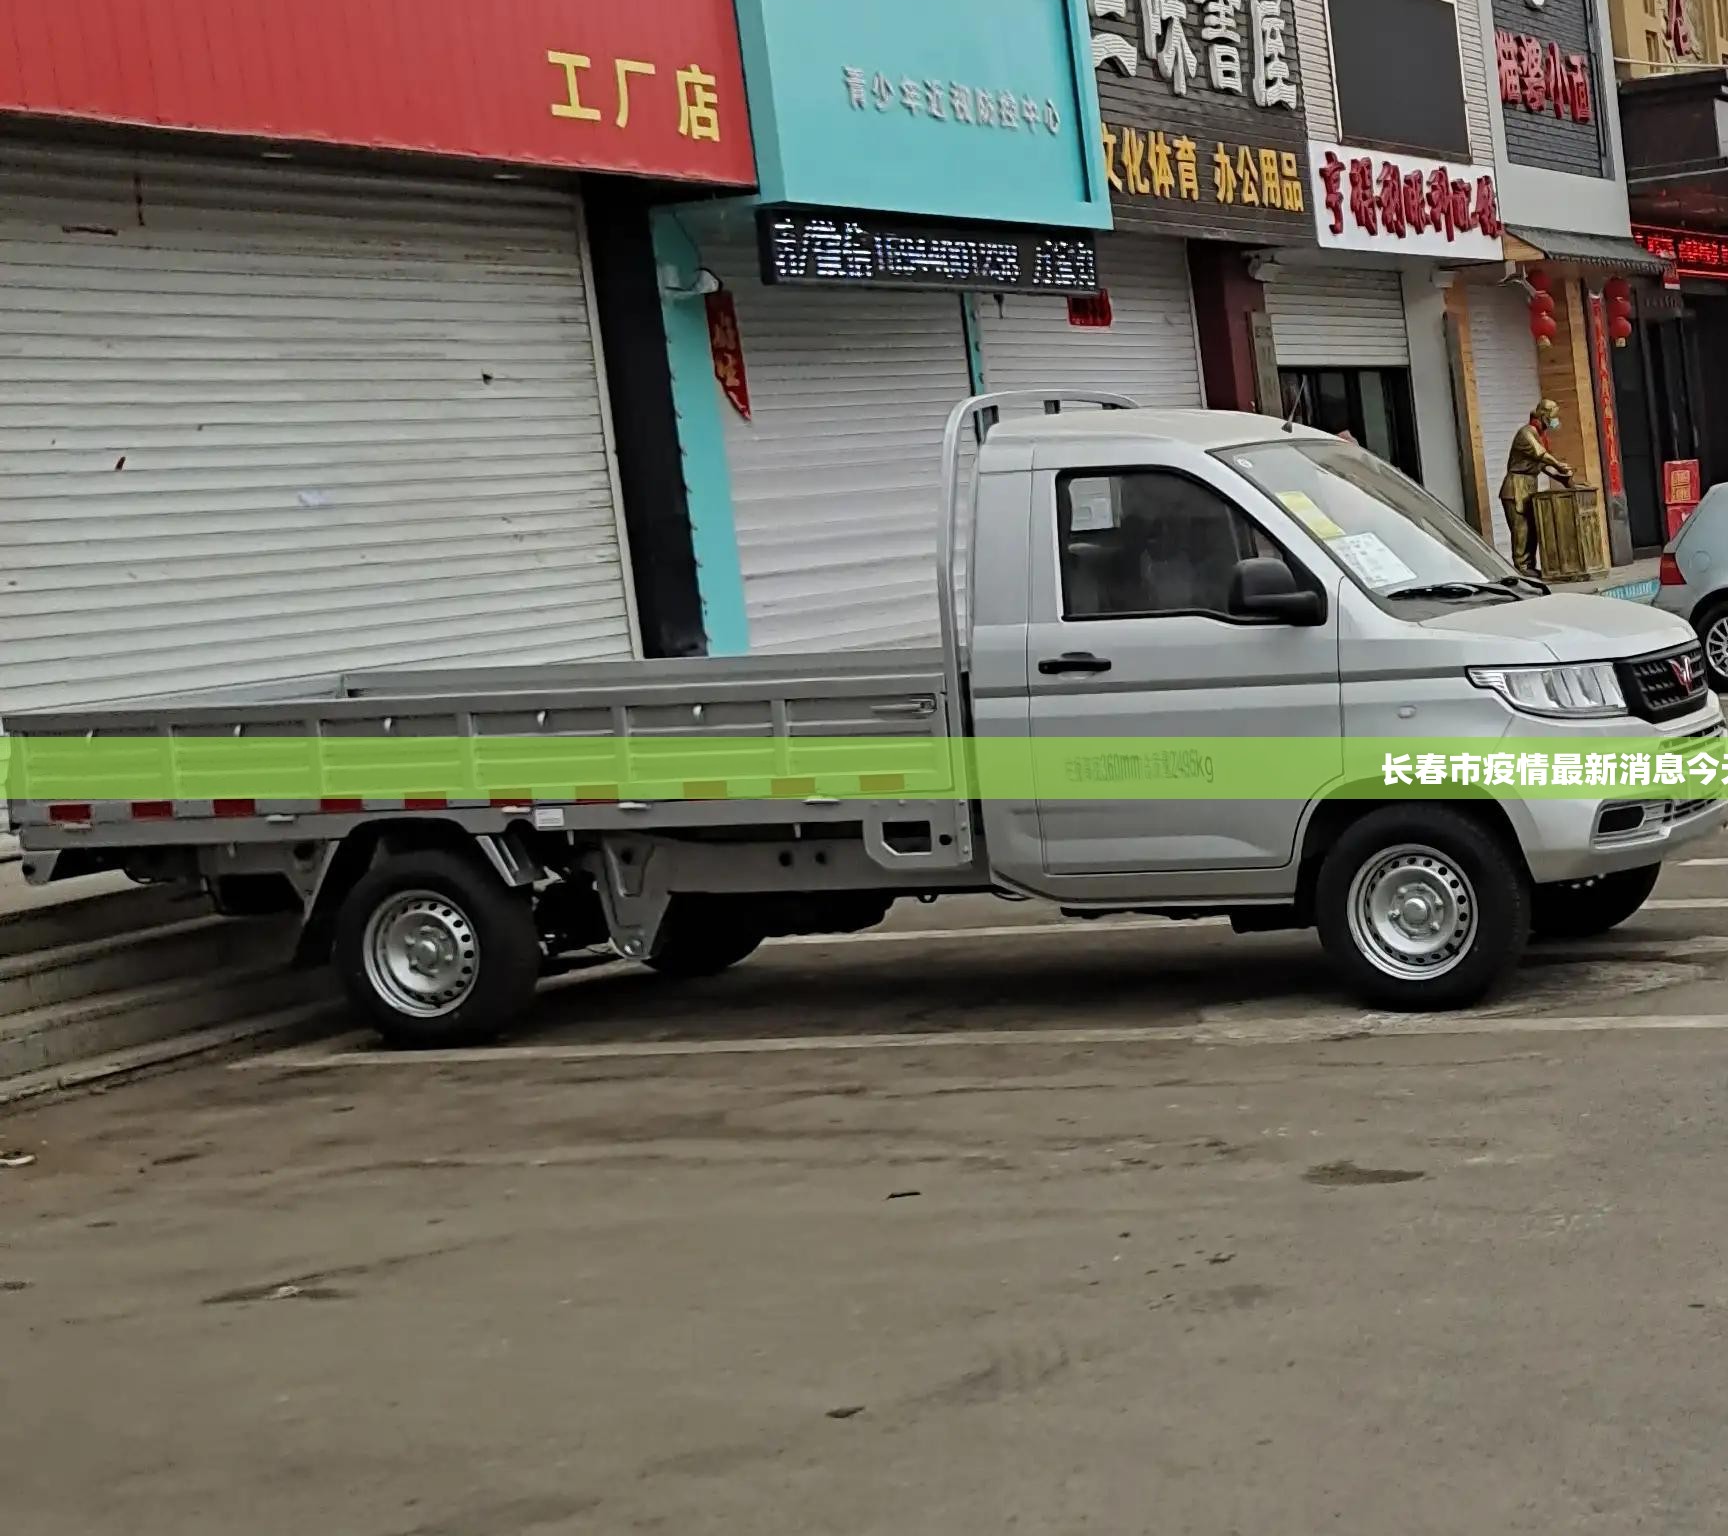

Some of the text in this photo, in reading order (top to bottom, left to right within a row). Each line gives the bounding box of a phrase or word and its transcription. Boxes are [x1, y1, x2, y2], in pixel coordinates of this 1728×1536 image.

[546, 50, 721, 144] 工厂店
[842, 64, 1060, 135] 青少年近视防控中心
[1102, 122, 1305, 212] 文化体育 办公用品
